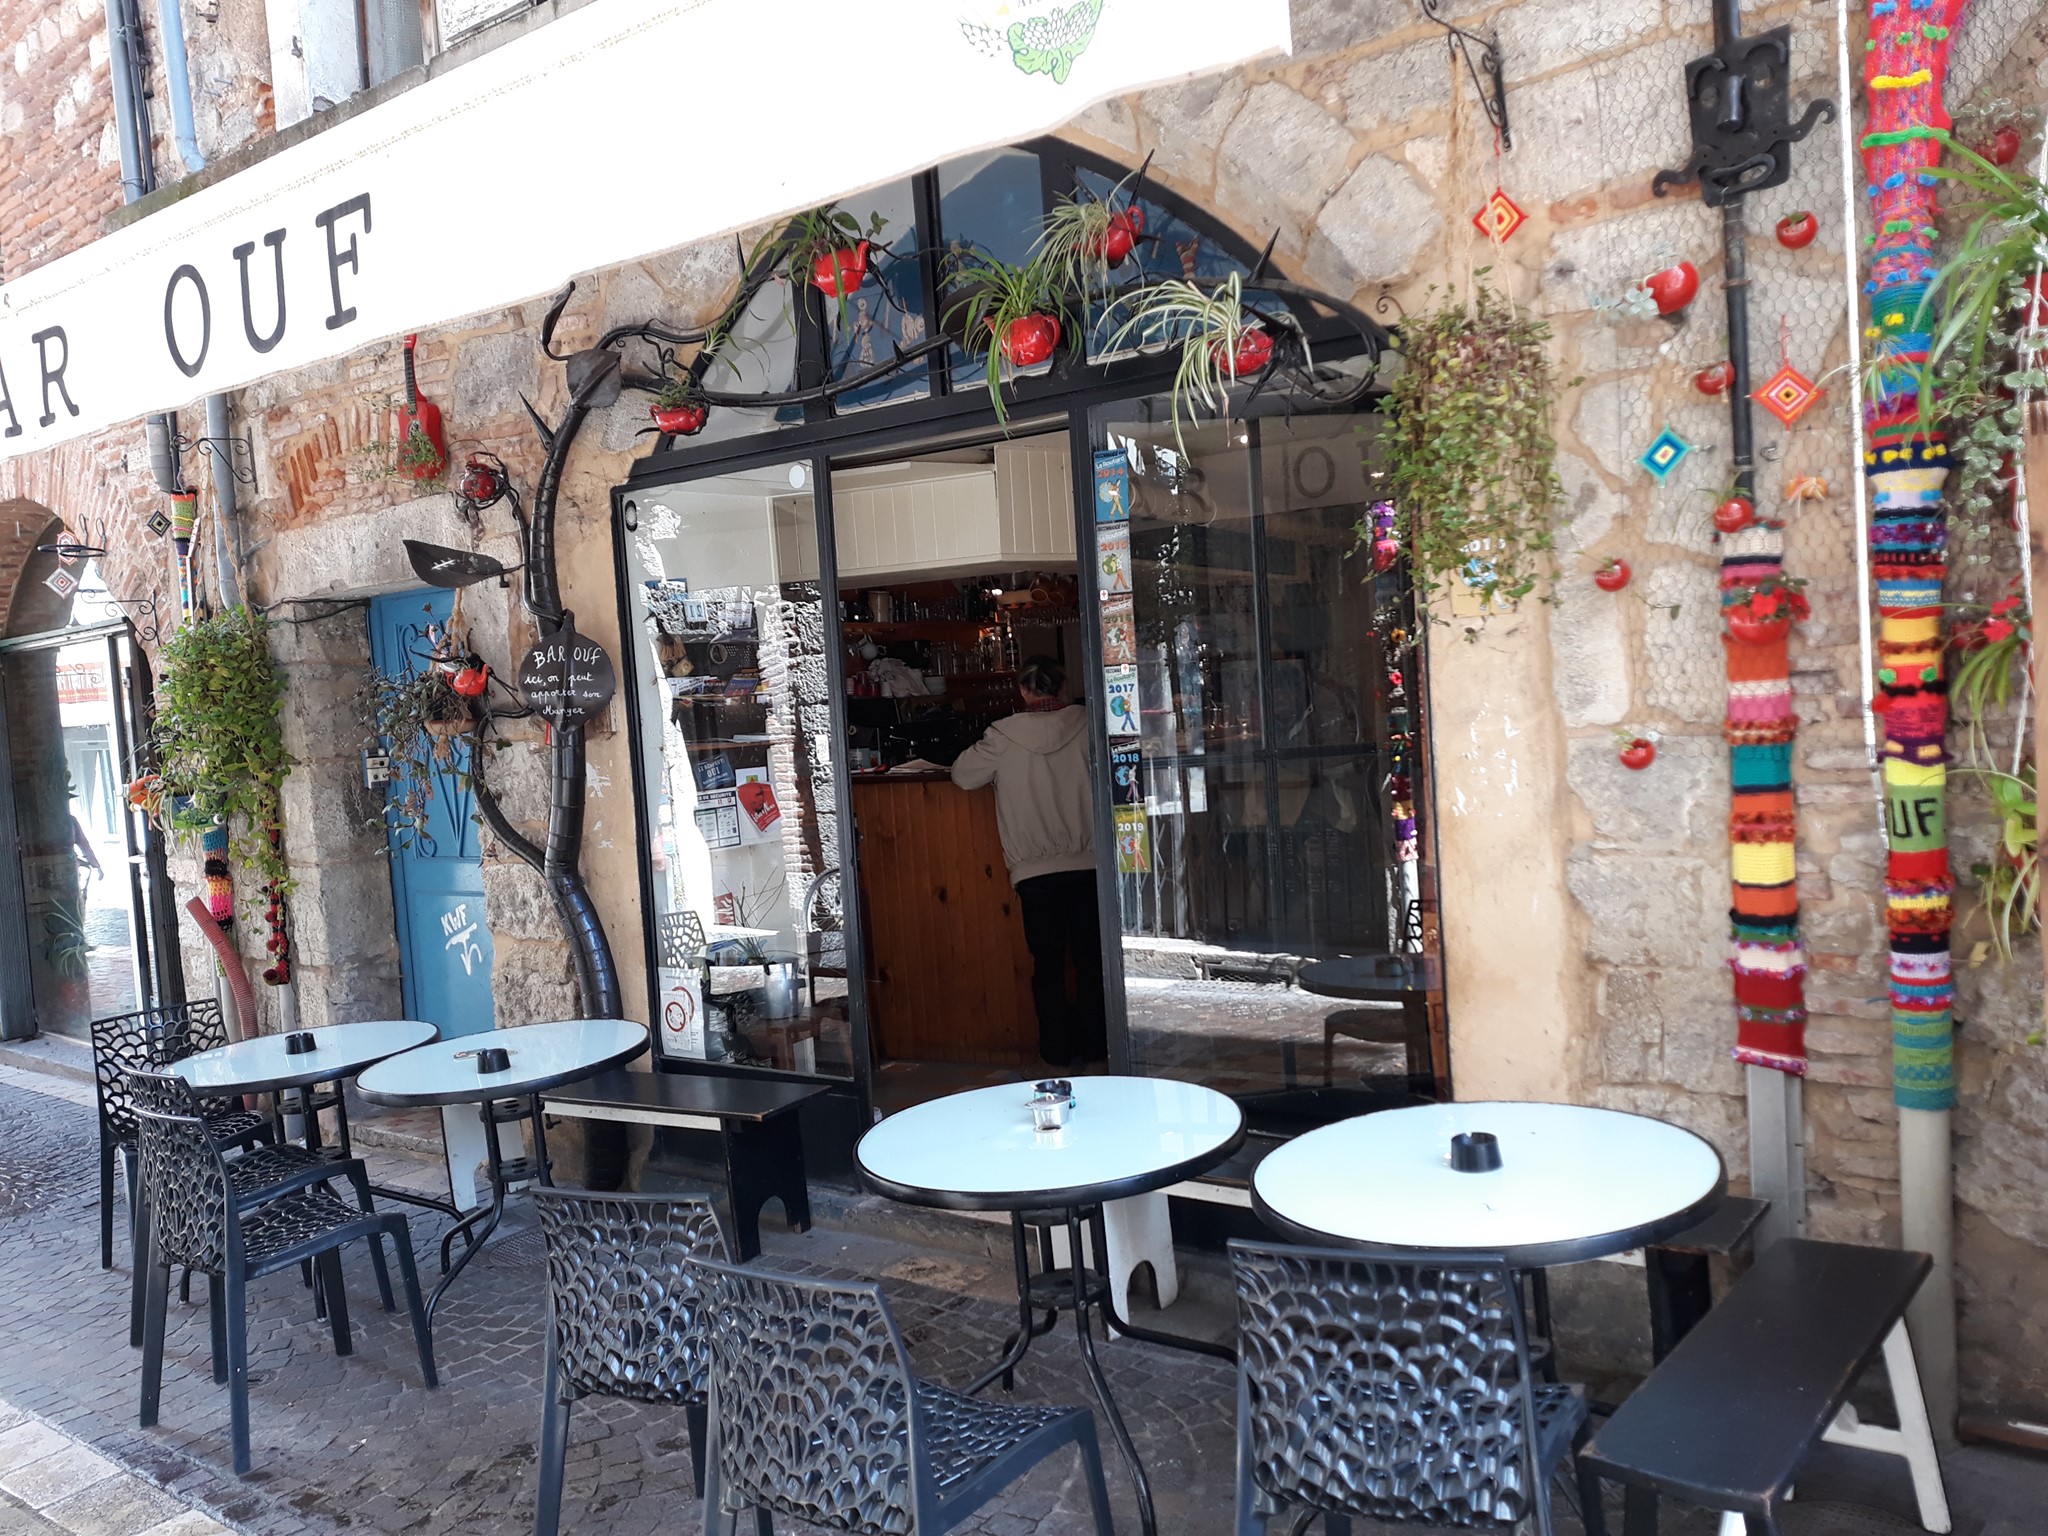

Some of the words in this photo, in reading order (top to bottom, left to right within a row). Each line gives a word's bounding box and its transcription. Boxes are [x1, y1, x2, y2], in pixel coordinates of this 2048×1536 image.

[163, 191, 373, 379] OUF
[1095, 461, 1103, 469] Le
[1102, 455, 1125, 467] Routard
[1097, 467, 1125, 478] 2014
[1109, 601, 1131, 612] Routard
[1103, 613, 1132, 625] 2016
[532, 645, 566, 669] BAR
[524, 673, 547, 687] ici,
[547, 675, 560, 683] on
[568, 672, 595, 687] peut
[1113, 672, 1136, 682] Routard
[1108, 683, 1135, 694] 2017
[531, 689, 577, 705] apporter
[582, 691, 603, 699] son
[542, 705, 586, 717] Manger
[1117, 743, 1140, 752] Routard
[1112, 752, 1140, 763] 2018
[1889, 797, 1939, 839] UF
[1118, 822, 1145, 832] 2019
